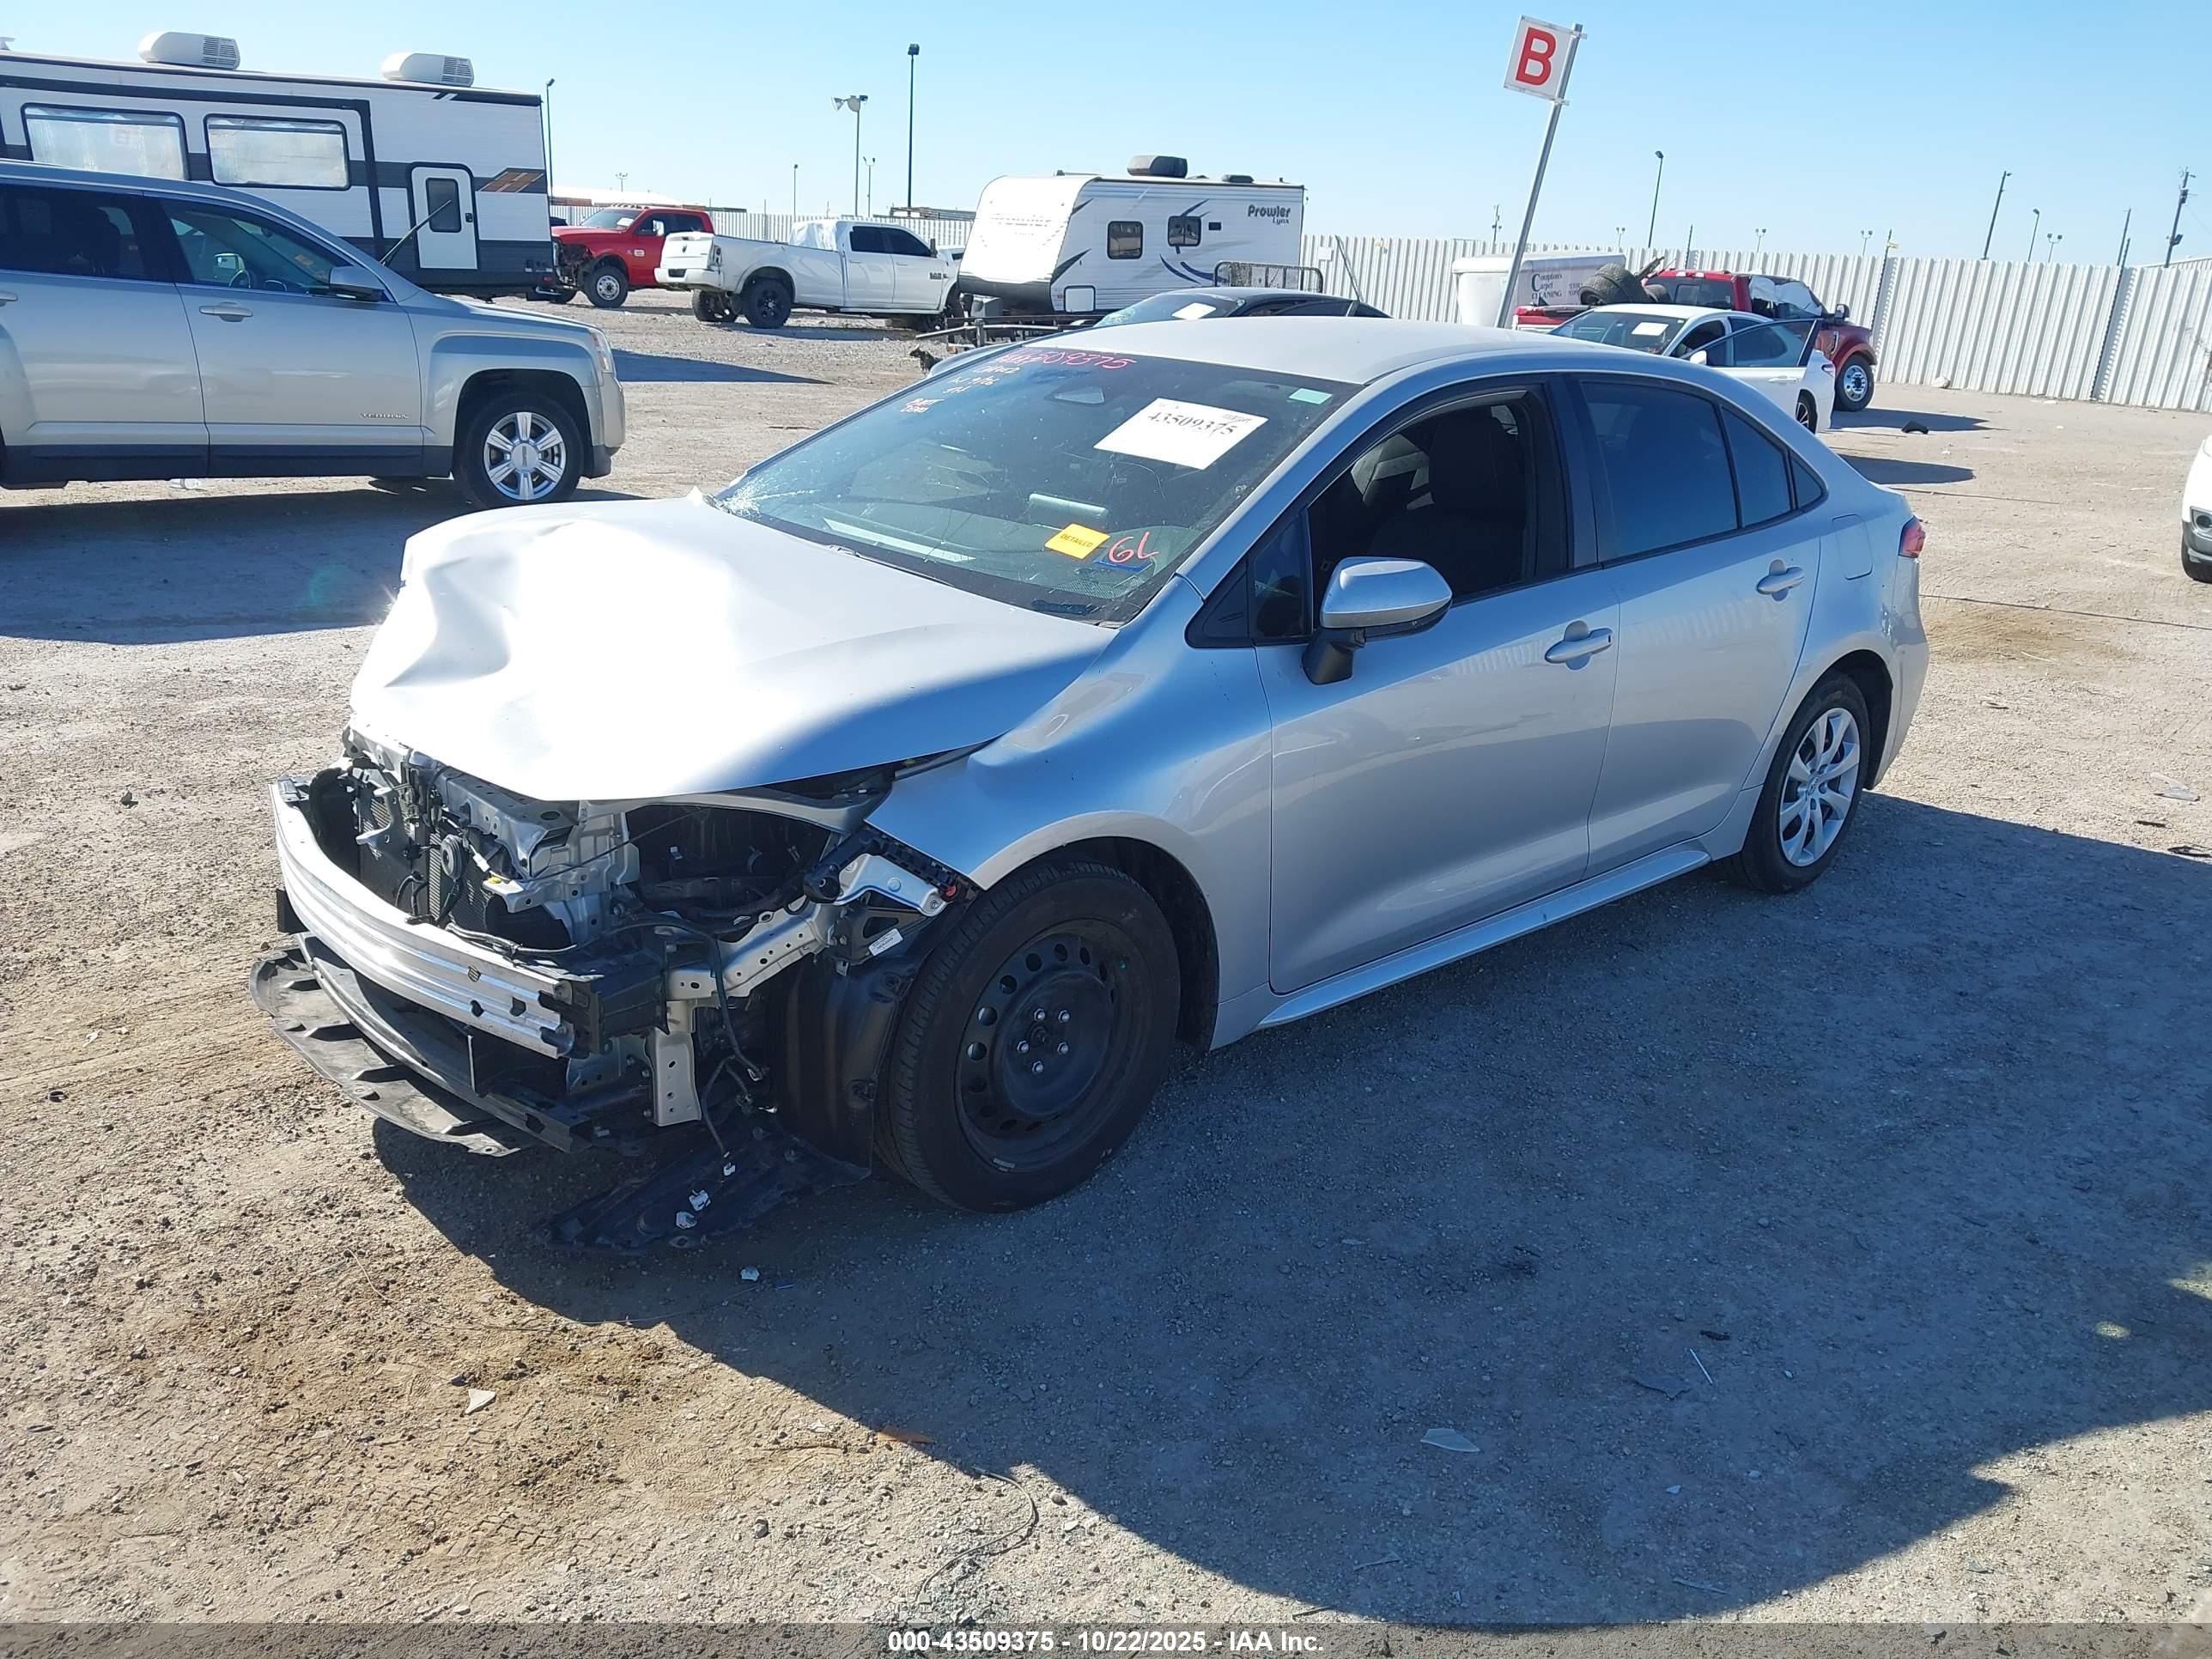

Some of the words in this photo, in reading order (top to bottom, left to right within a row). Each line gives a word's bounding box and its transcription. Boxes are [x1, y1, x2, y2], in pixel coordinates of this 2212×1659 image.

[1516, 27, 1556, 85] B
[1248, 204, 1291, 217] Prowler
[1147, 412, 1237, 434] 43509375
[1060, 533, 1094, 548] DETAILED
